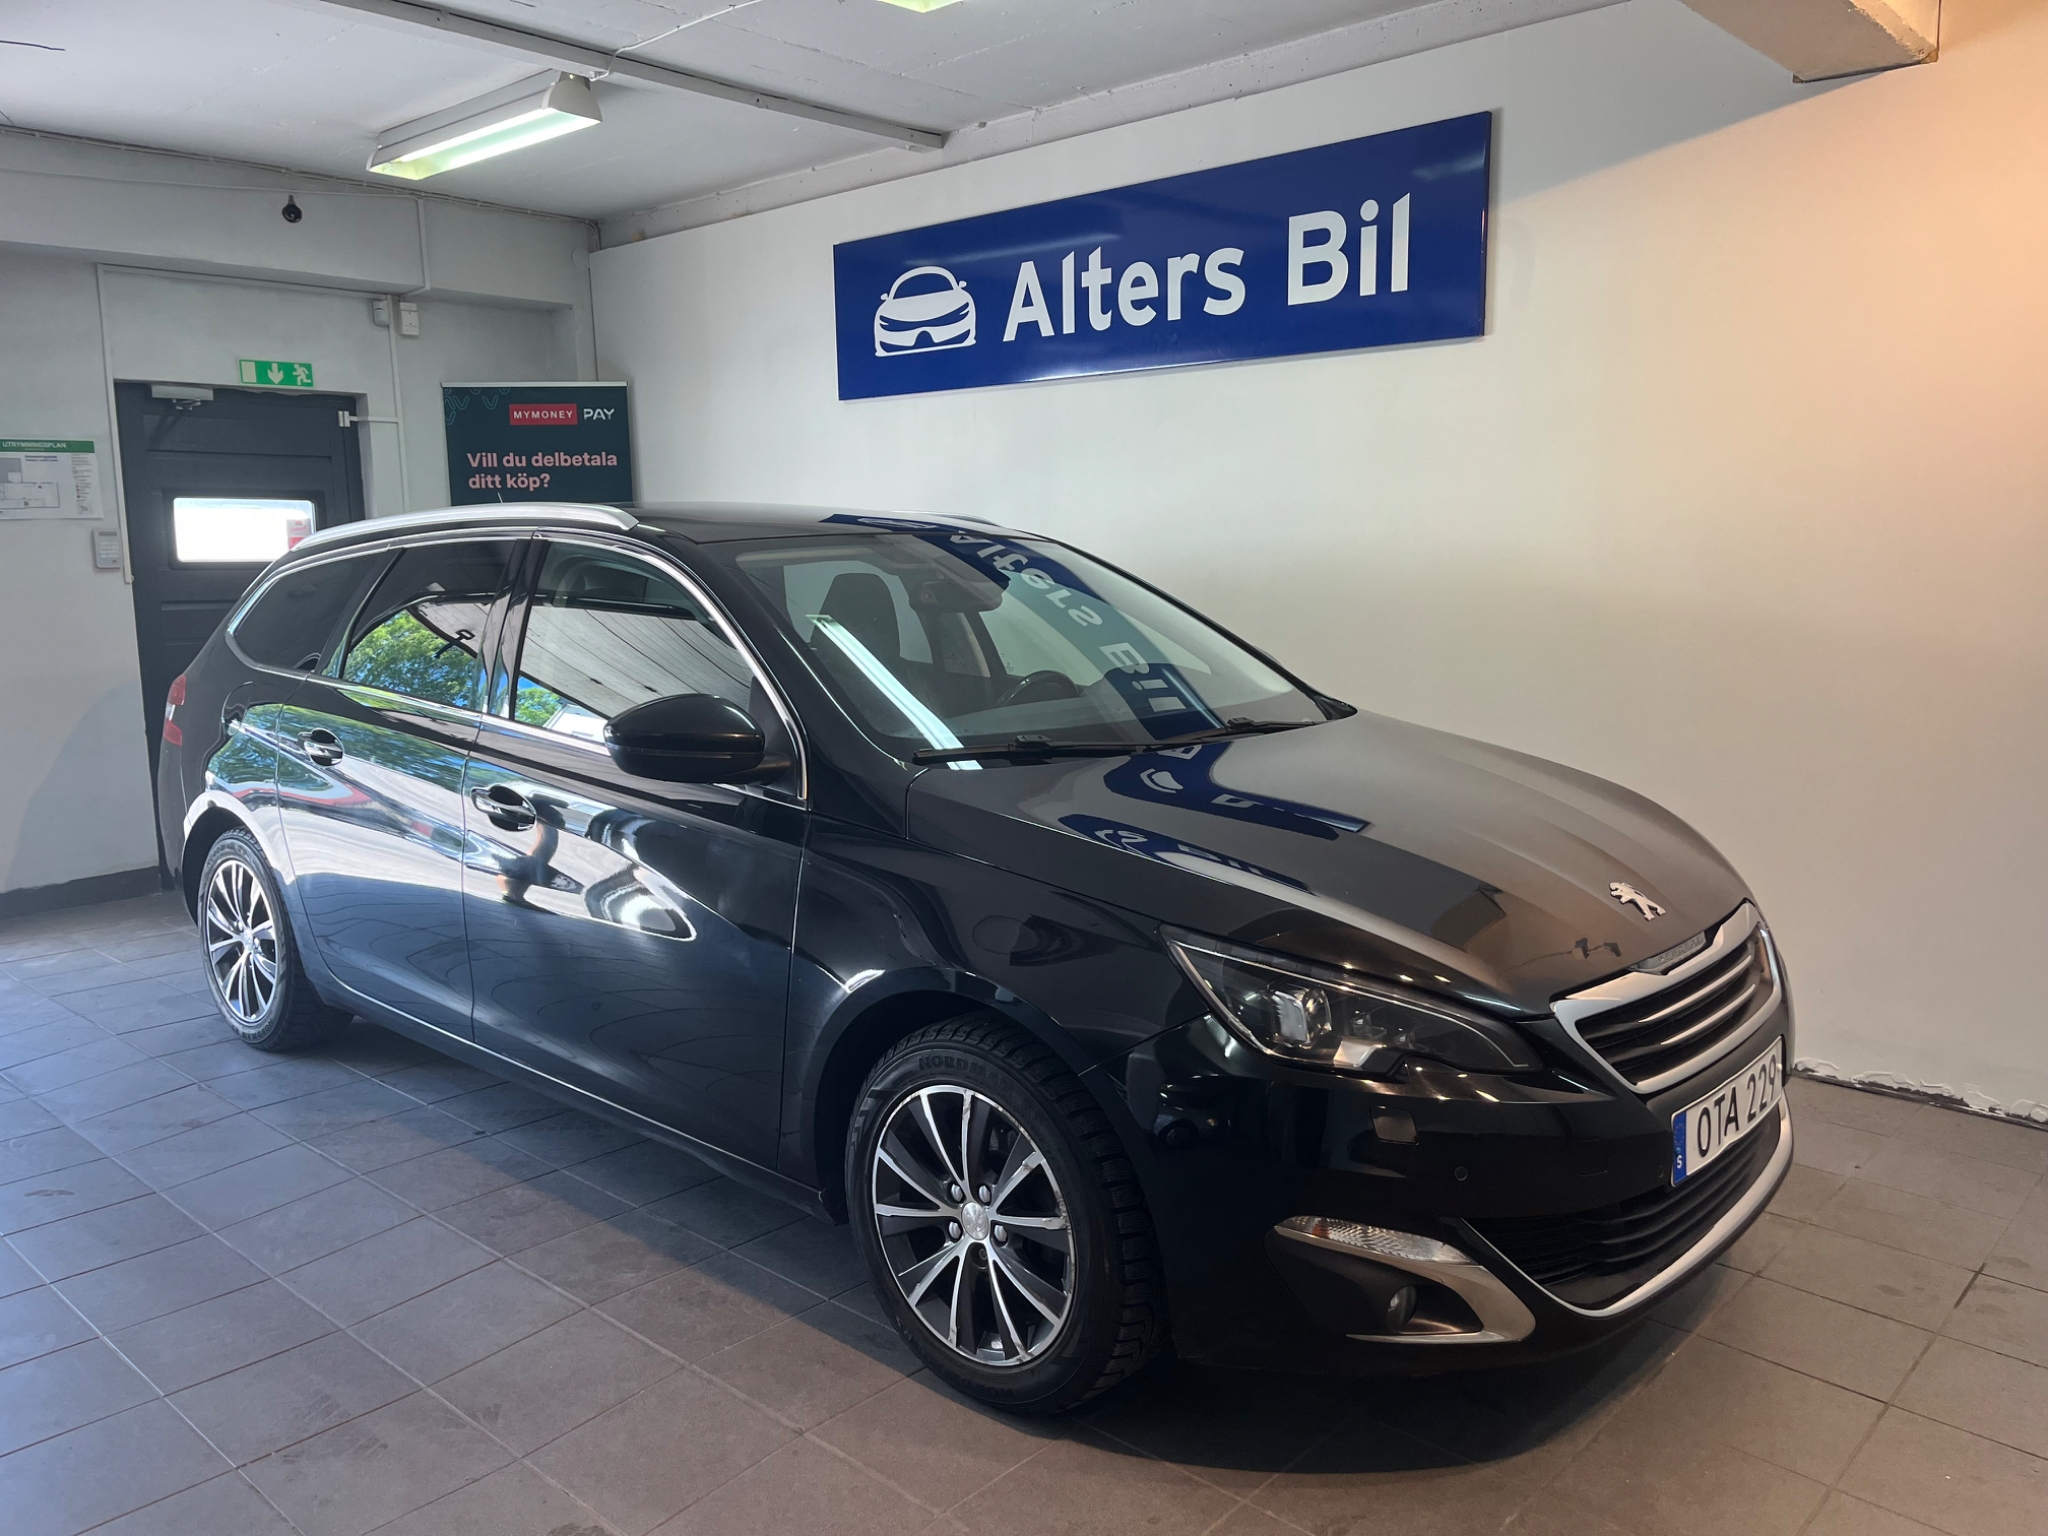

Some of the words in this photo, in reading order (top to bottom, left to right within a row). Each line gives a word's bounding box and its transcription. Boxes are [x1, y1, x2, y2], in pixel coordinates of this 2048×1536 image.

[1002, 246, 1246, 342] Alters
[1287, 192, 1411, 306] Bil
[513, 410, 574, 419] MYMONEY
[583, 408, 615, 421] PAY
[467, 452, 498, 468] Vill
[503, 452, 527, 467] du
[531, 451, 618, 467] delbetala
[468, 473, 502, 489] ditt
[506, 472, 551, 492] köp?
[1697, 1086, 1740, 1158] OTA
[1746, 1053, 1777, 1124] 229
[1676, 1155, 1683, 1169] S
